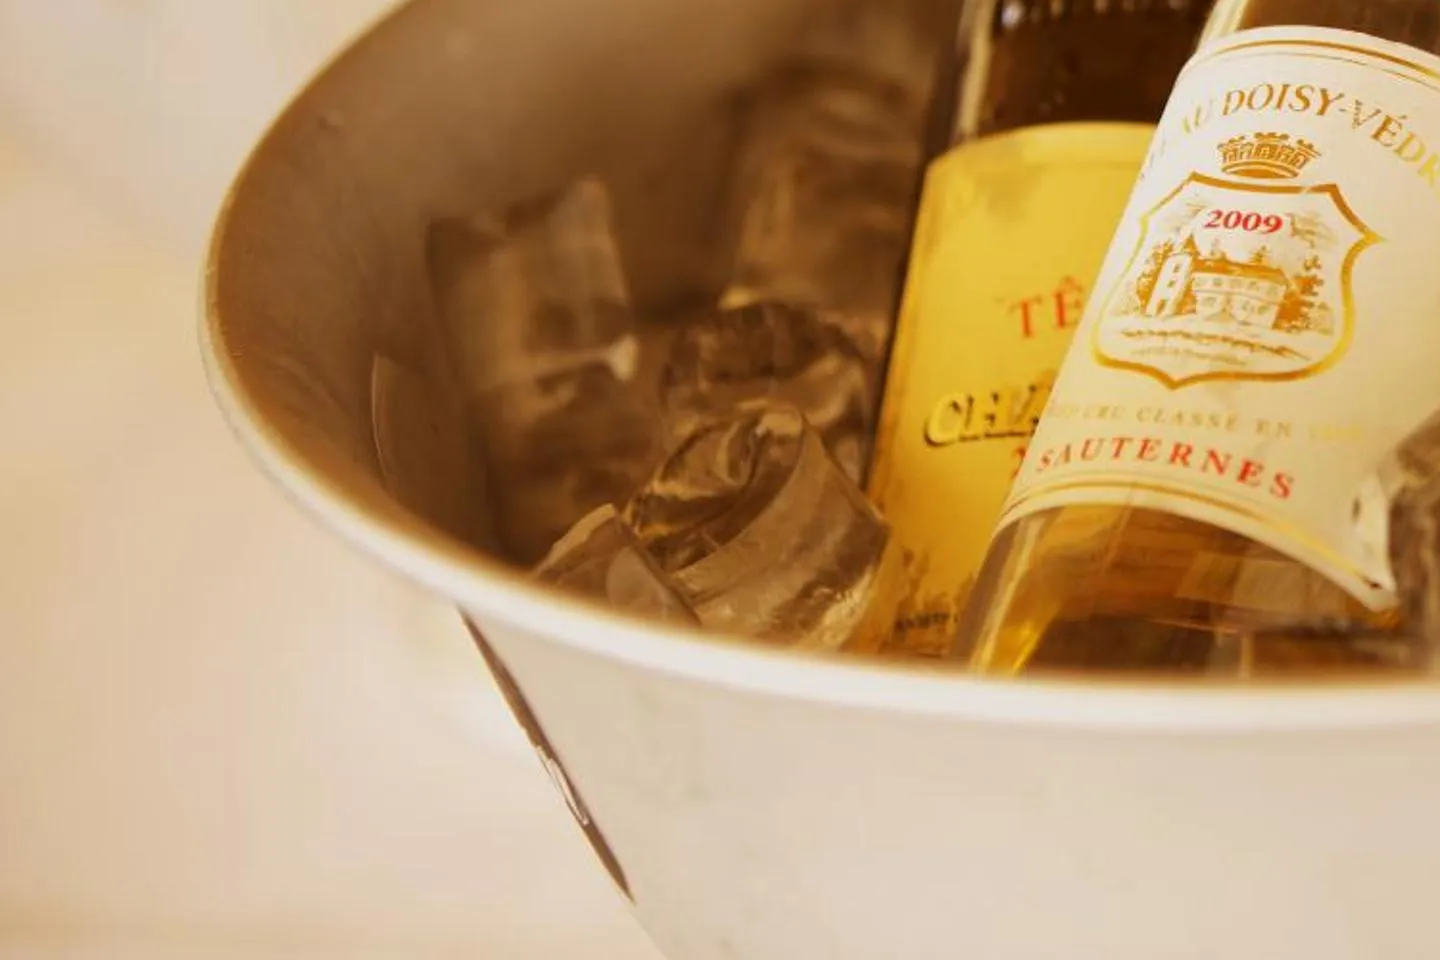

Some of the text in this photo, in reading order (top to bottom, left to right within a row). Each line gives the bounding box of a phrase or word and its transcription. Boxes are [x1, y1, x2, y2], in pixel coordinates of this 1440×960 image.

[1203, 208, 1284, 235] 2009
[1256, 418, 1293, 438] EN
[1036, 436, 1298, 501] SAUTERNES
